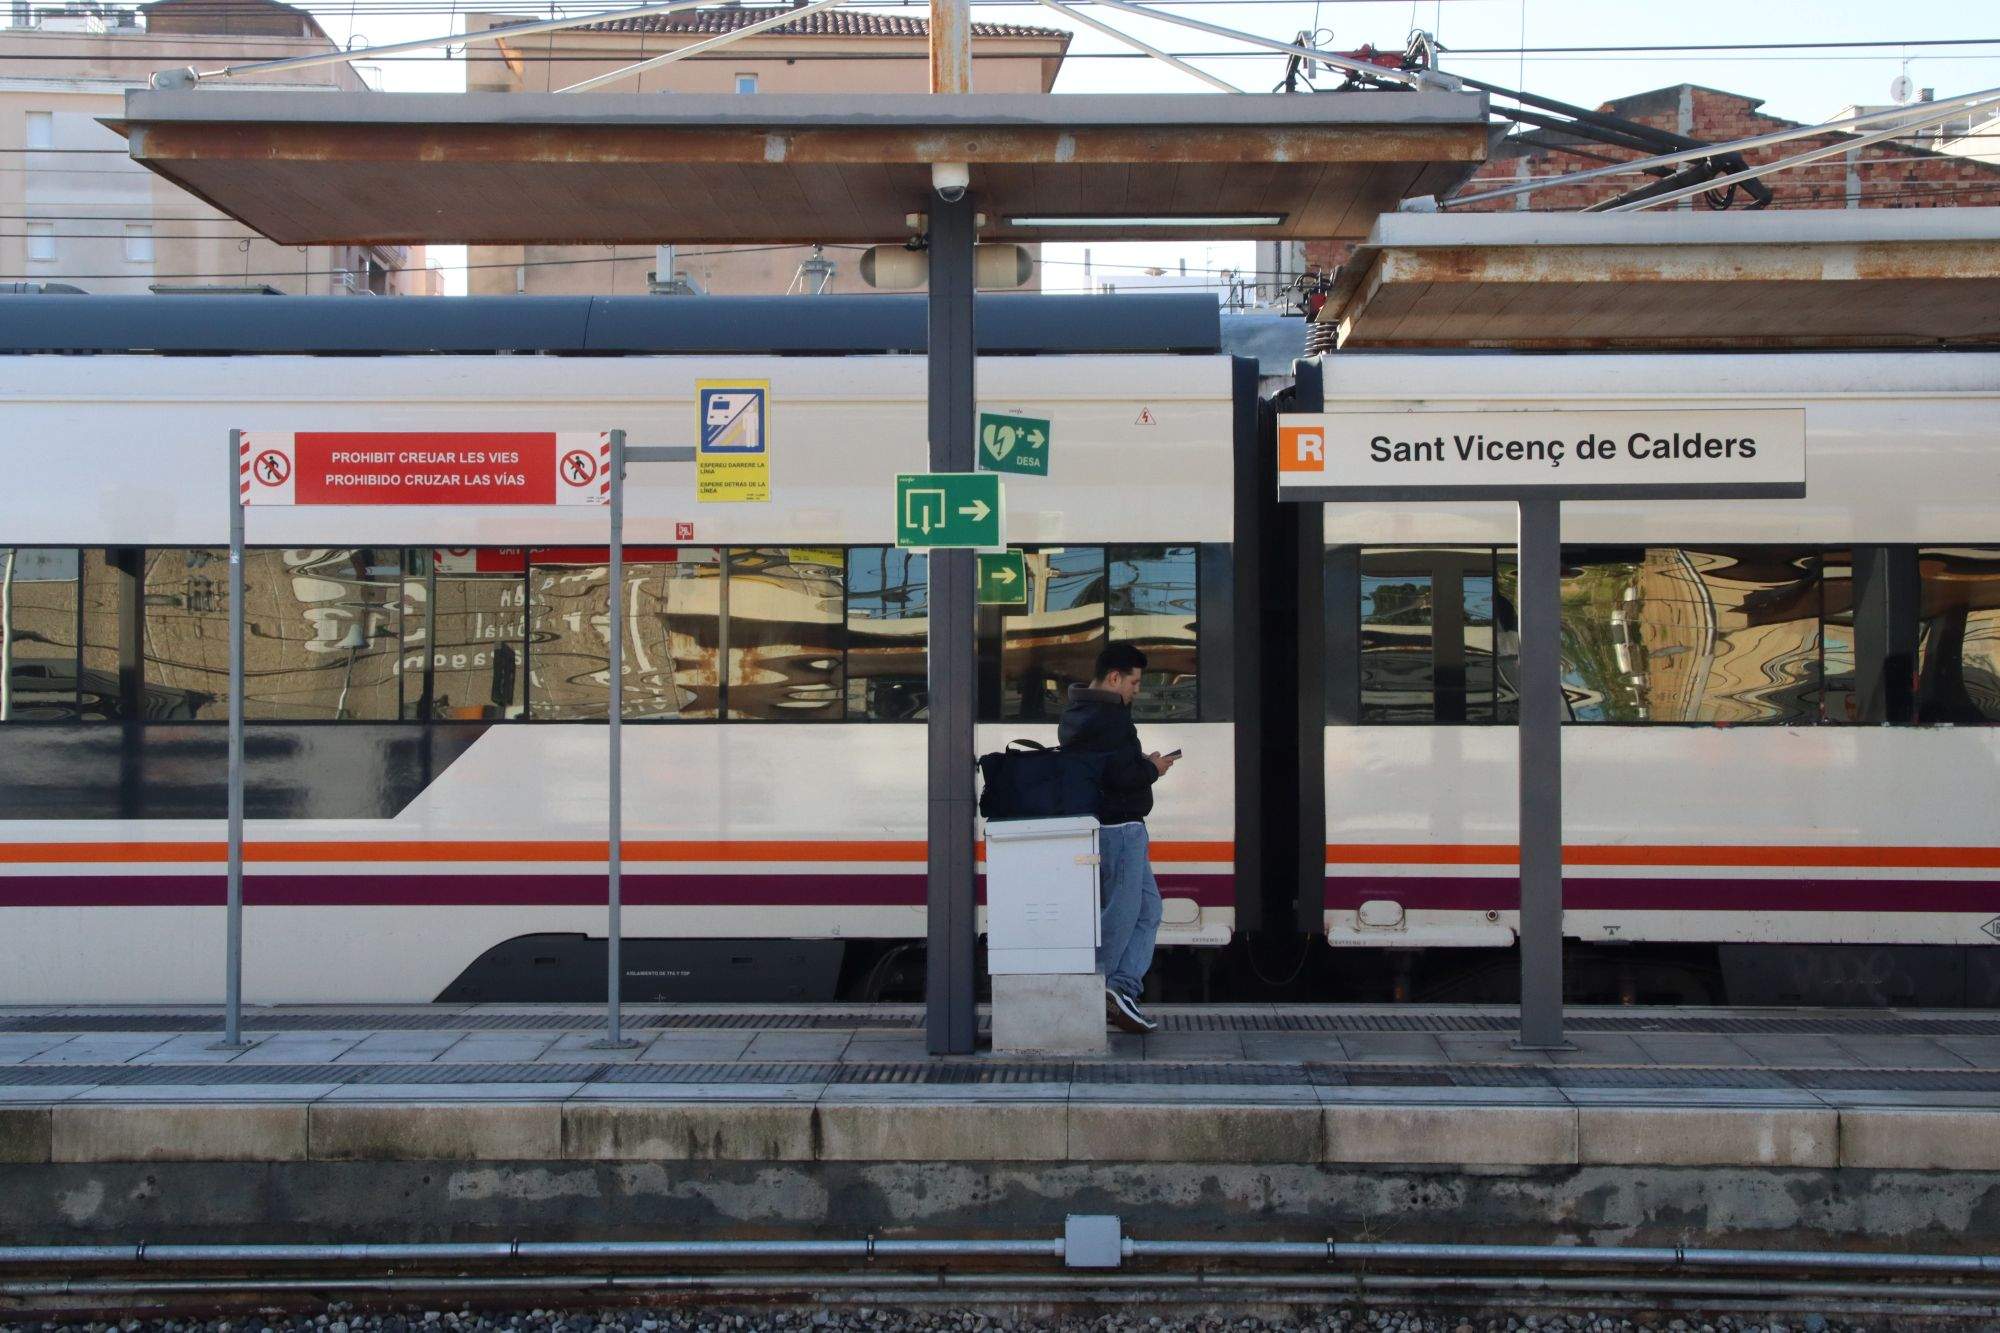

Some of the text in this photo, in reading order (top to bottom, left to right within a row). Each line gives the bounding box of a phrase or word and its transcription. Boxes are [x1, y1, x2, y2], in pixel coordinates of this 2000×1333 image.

[1296, 434, 1325, 462] R
[1371, 433, 1757, 468] Sant Vicenç de Calders
[331, 452, 519, 463] PROHIBIT CREUAR LES VIES
[1017, 456, 1041, 467] DESA
[325, 472, 526, 485] PROHIBIDO CRUZAR LAS VÍAS
